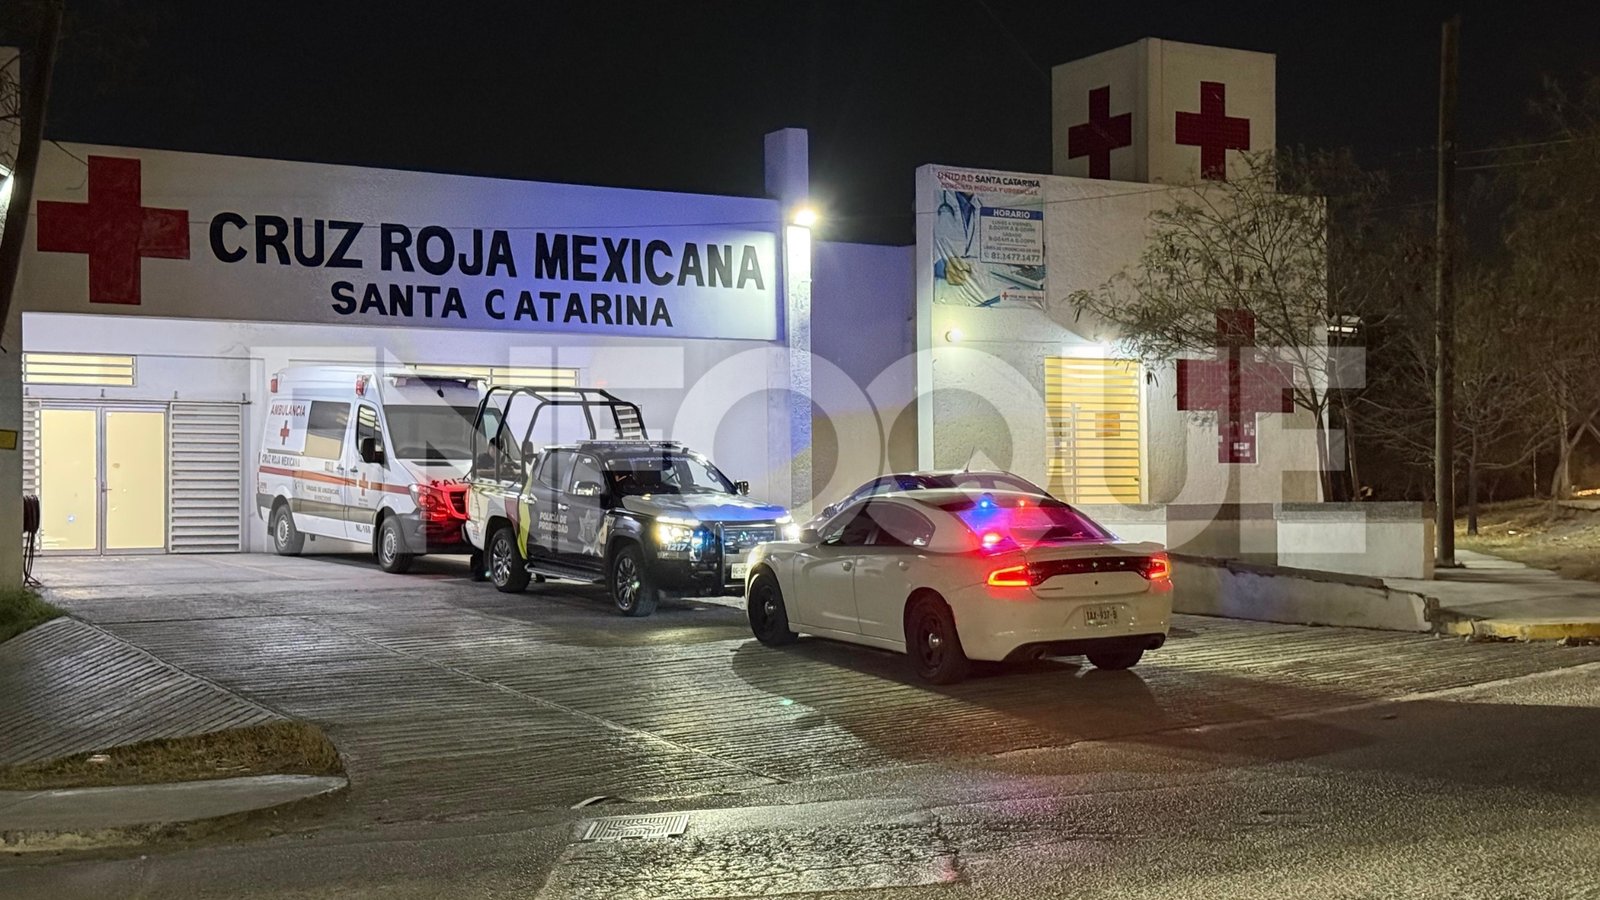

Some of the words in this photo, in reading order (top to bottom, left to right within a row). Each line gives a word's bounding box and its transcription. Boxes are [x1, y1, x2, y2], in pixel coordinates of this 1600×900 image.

[975, 174, 1001, 184] SANTA
[1002, 178, 1040, 187] CATARINA
[993, 208, 1031, 219] HORARIO
[209, 212, 364, 269] CRUZ
[380, 223, 517, 278] ROJA
[535, 232, 766, 290] MEXICANA
[331, 281, 467, 318] SANTA
[485, 290, 673, 327] CATARINA
[271, 404, 305, 416] AMBULANCIA
[560, 514, 567, 524] DE
[667, 542, 687, 551] 1217
